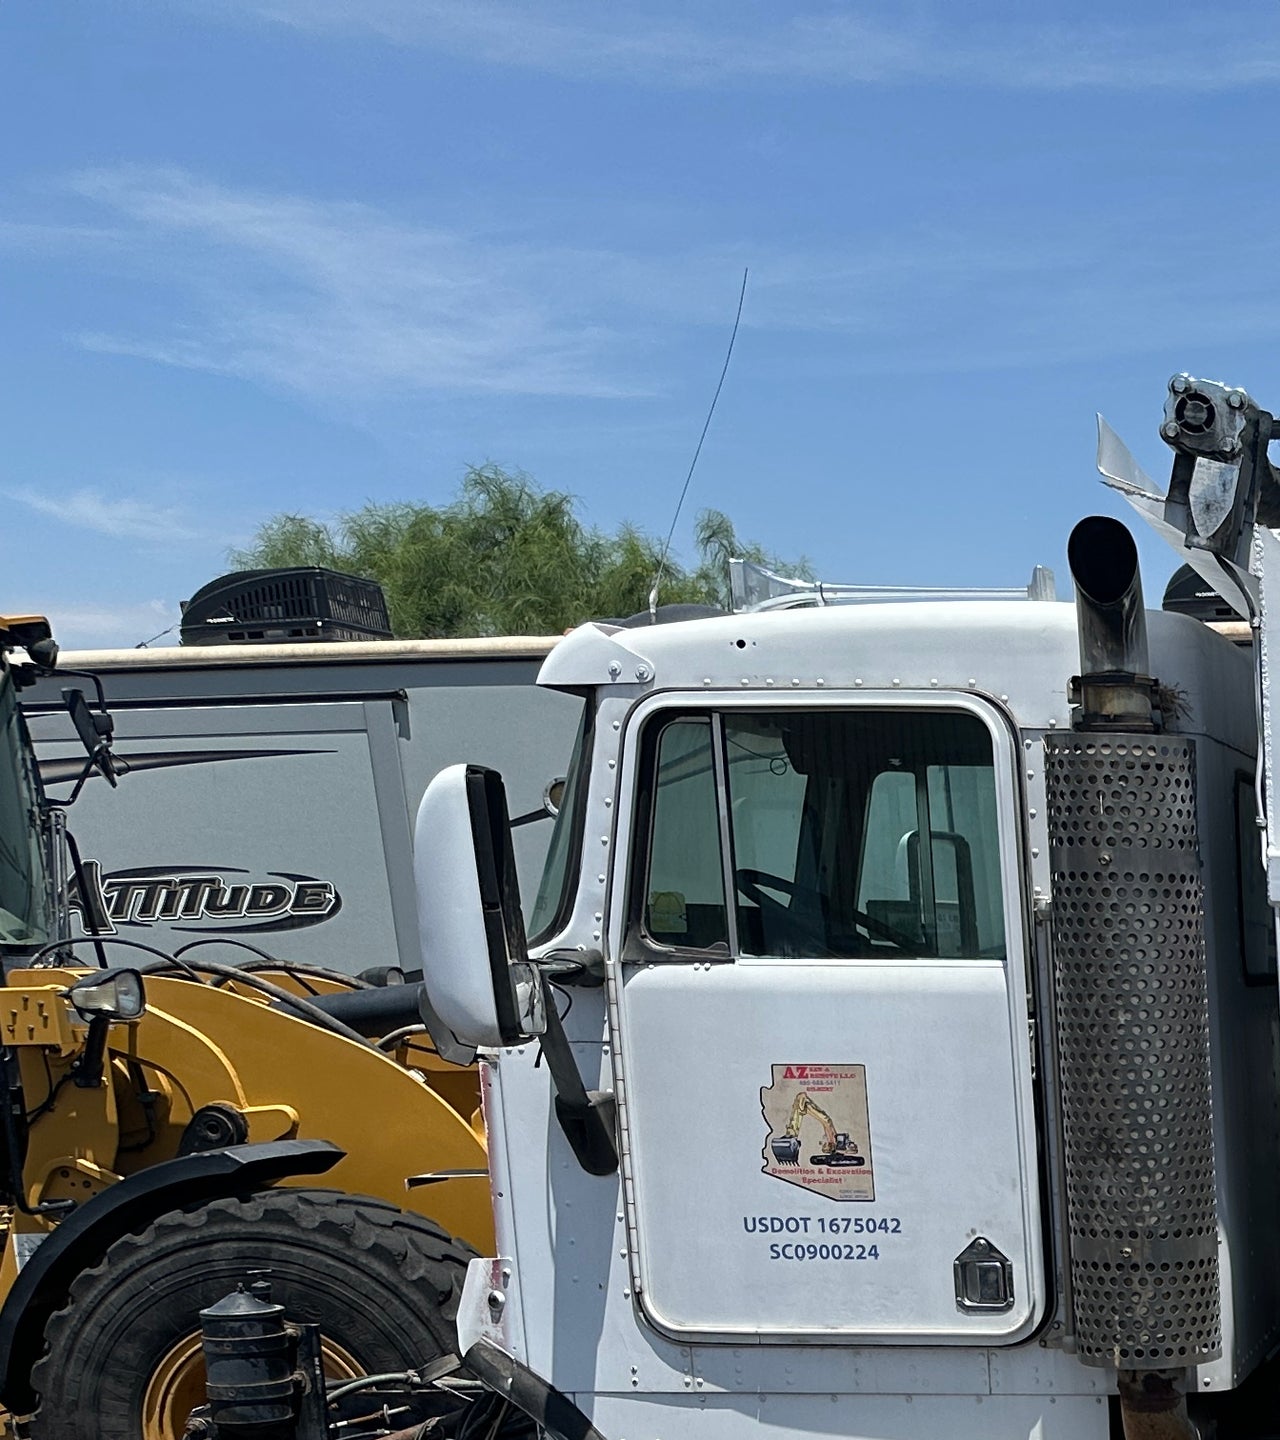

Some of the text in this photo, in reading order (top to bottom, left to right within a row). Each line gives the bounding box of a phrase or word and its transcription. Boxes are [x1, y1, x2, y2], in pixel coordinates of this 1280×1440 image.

[68, 859, 336, 935] ATTITUDE
[783, 1065, 809, 1079] AZ
[771, 1167, 816, 1176] Demolition
[826, 1168, 873, 1176] Excavation
[743, 1216, 902, 1234] USDOT 1675042
[769, 1243, 880, 1261] SC0900224
